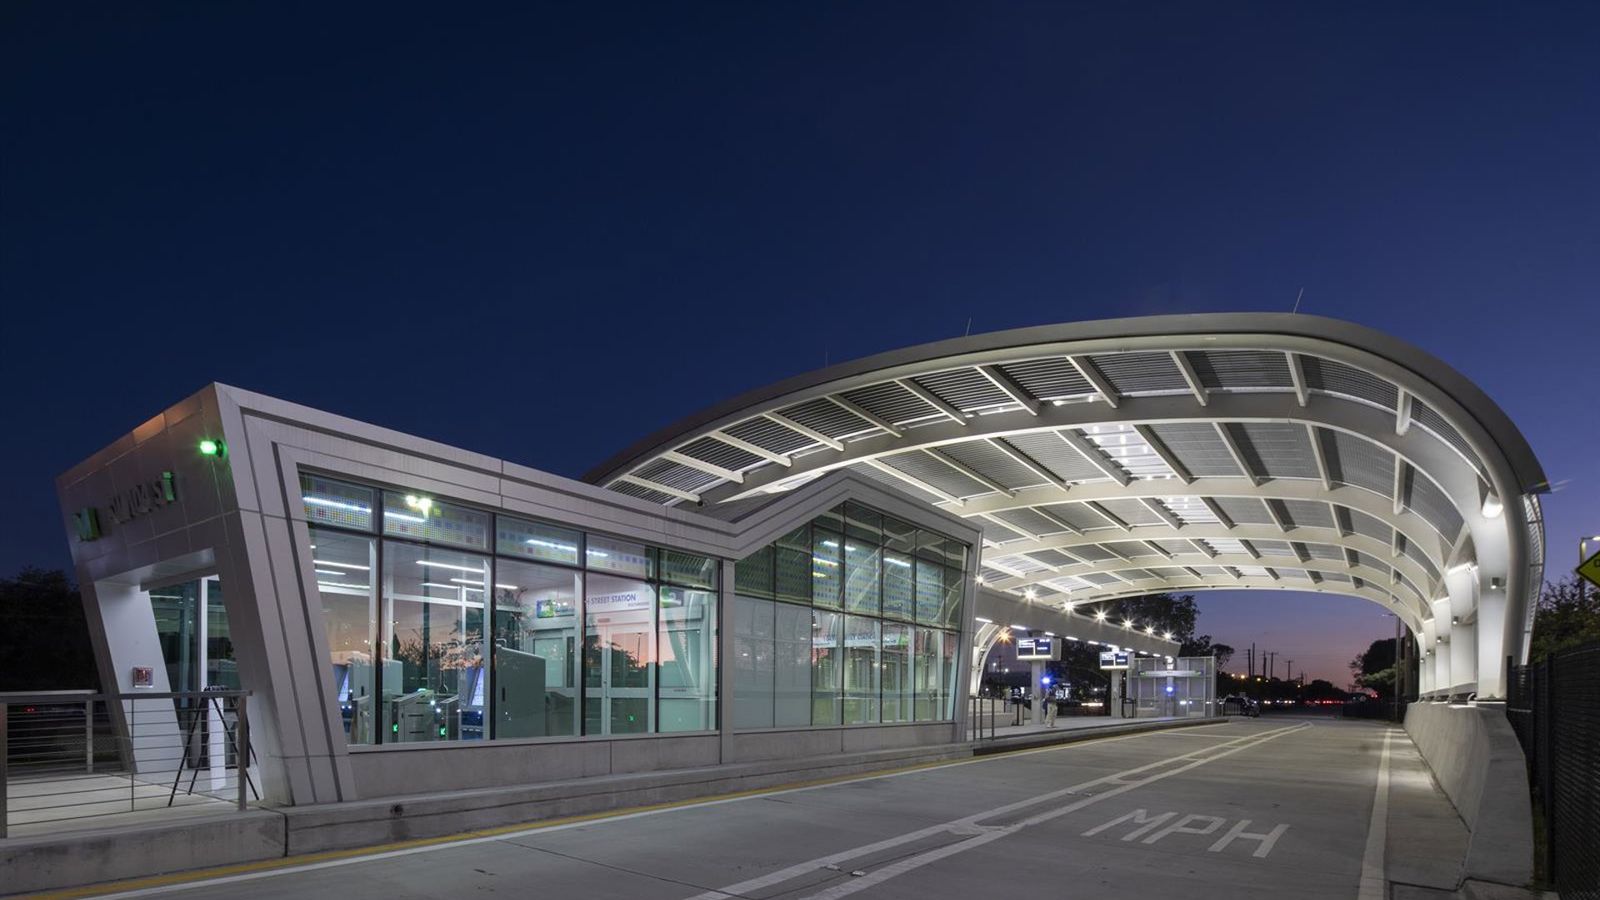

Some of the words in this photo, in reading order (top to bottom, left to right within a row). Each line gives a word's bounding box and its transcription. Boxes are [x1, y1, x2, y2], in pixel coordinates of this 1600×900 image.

[591, 596, 610, 605] STREET
[612, 593, 636, 603] STATION
[1081, 808, 1290, 858] MPH
